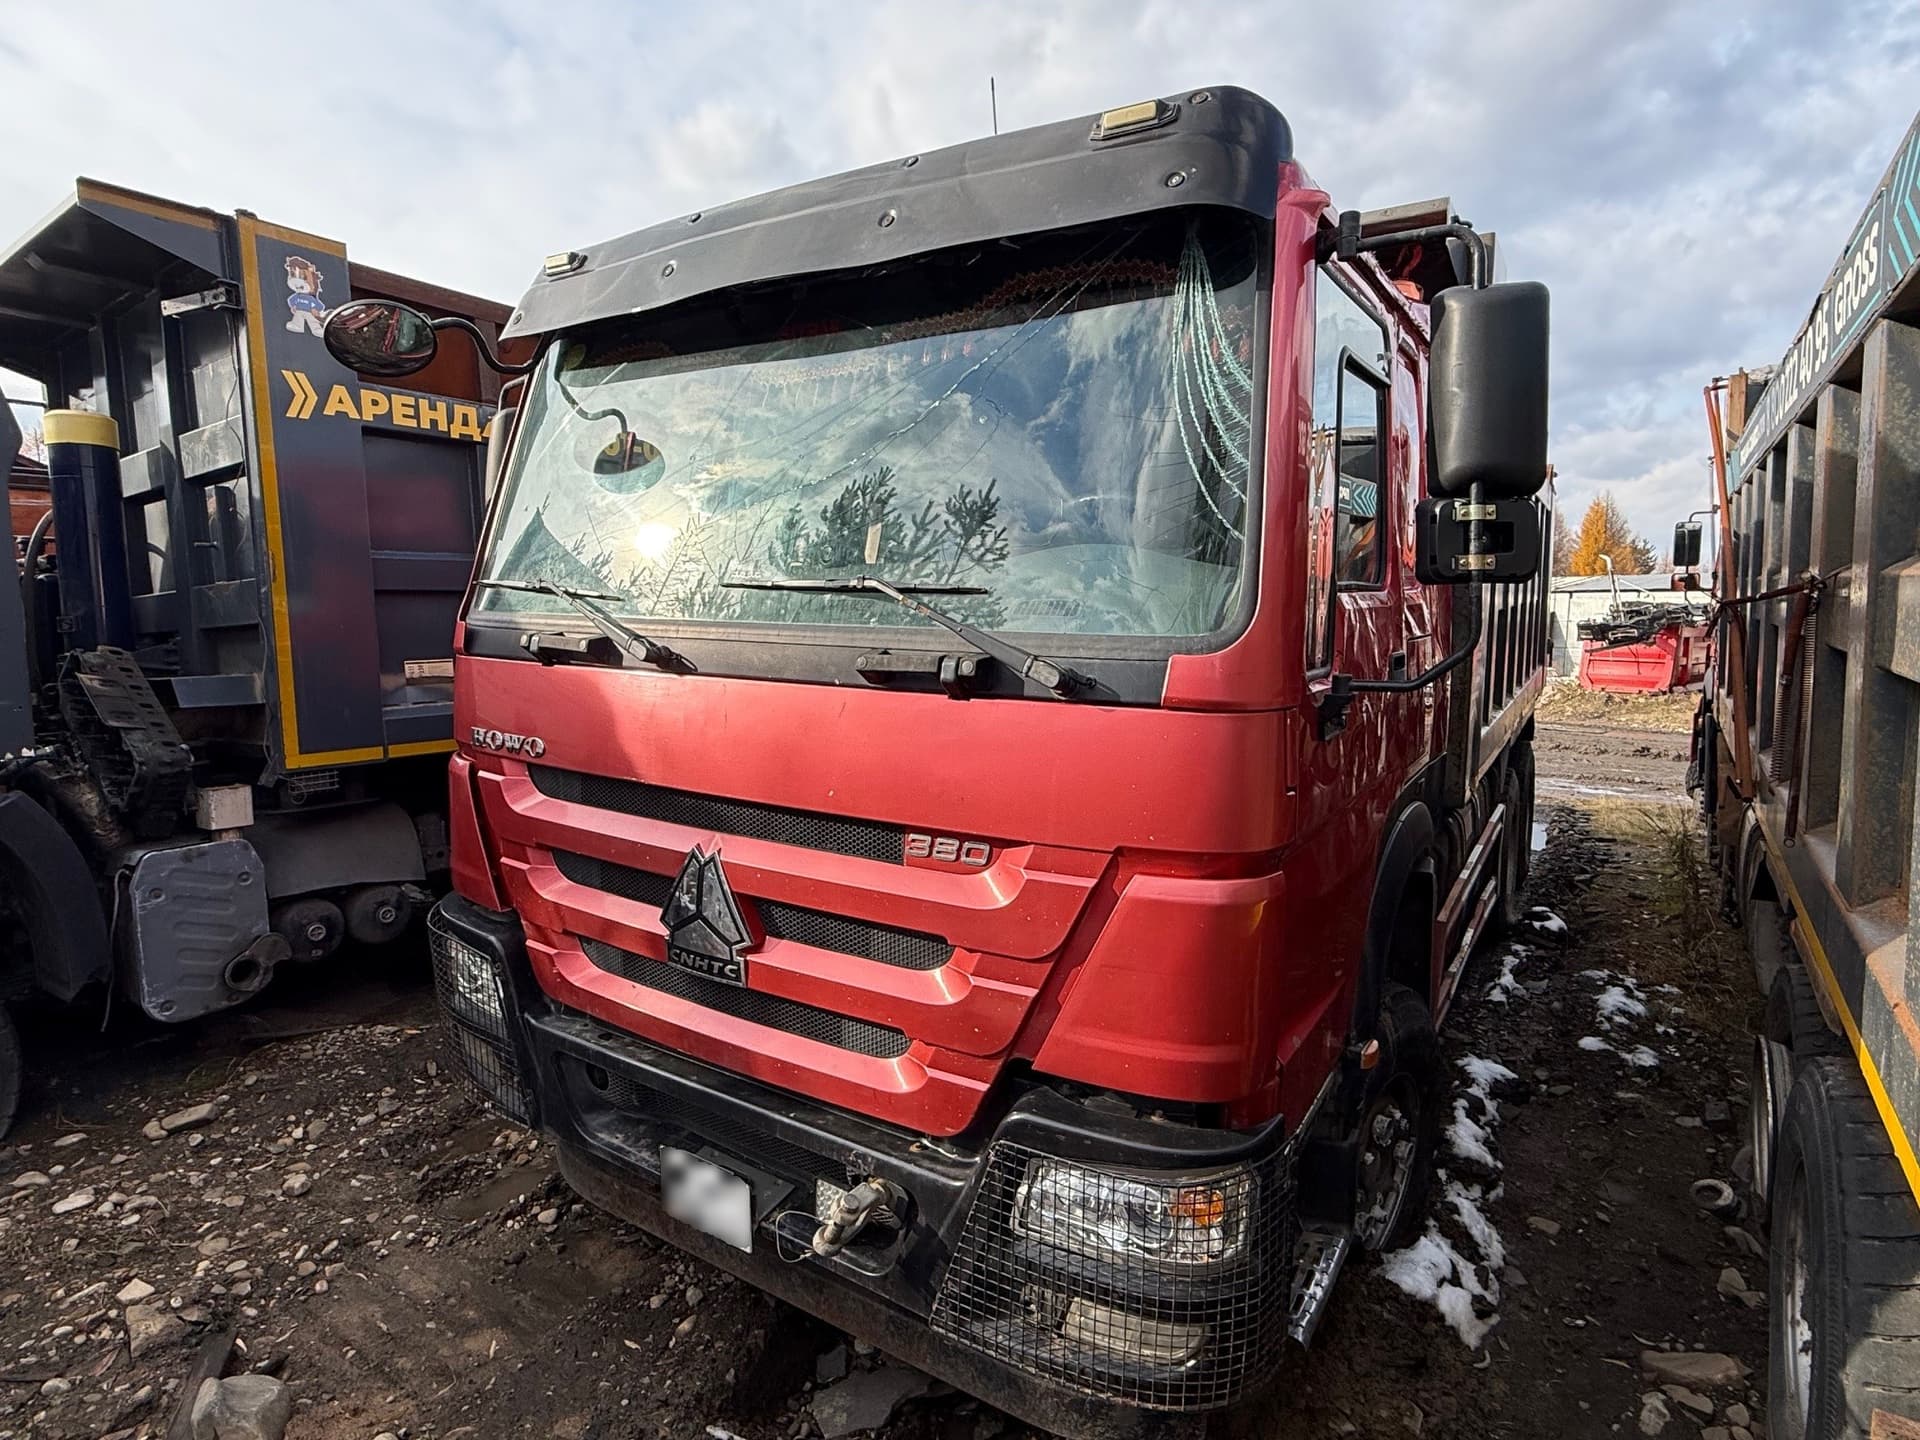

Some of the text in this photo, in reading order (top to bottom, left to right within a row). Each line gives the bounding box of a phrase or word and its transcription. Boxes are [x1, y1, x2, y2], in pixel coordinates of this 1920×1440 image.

[1834, 220, 1879, 335] GROSS
[471, 726, 546, 757] HOWO
[906, 832, 990, 866] 380
[671, 948, 738, 978] CNHTC
